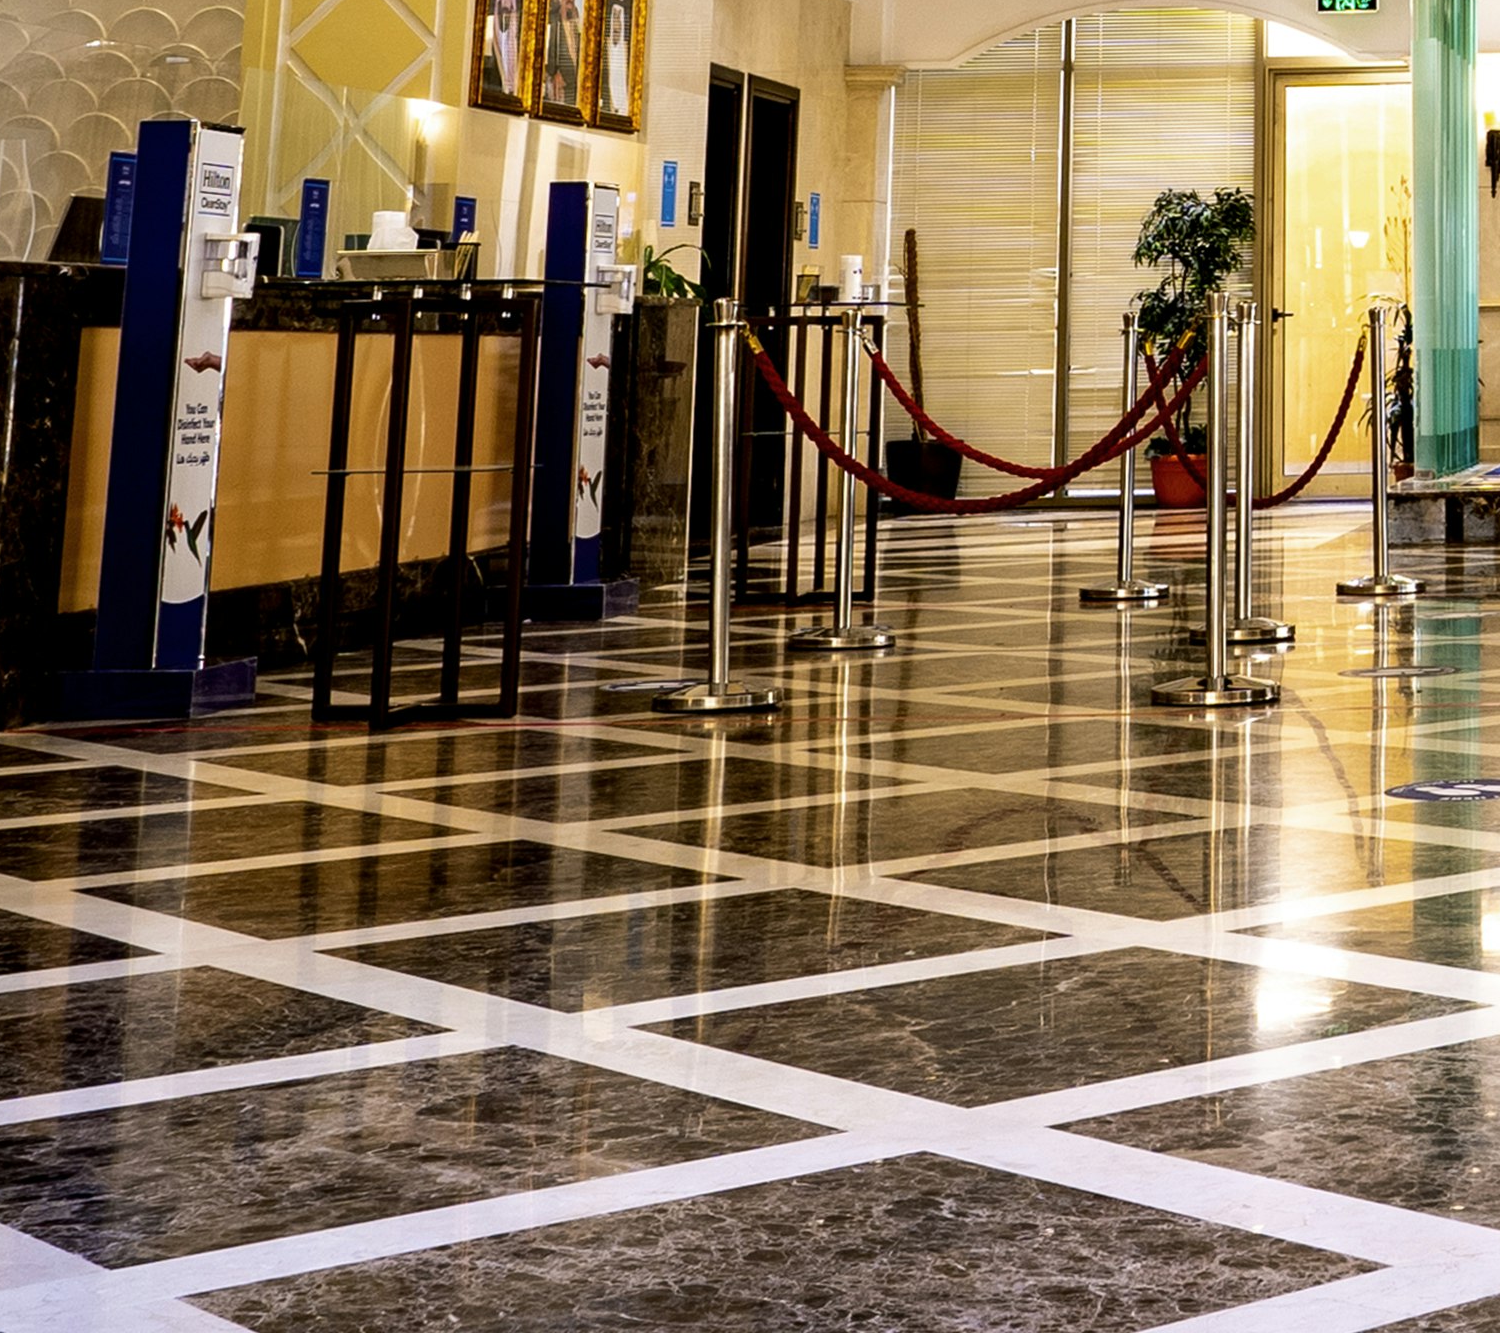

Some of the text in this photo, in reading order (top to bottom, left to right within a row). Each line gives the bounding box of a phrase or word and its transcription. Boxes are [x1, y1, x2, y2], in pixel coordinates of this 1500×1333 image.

[203, 170, 230, 190] Hilton
[595, 219, 612, 233] Hilton
[186, 403, 208, 414] You Can
[177, 418, 215, 430] Disinfect Your
[181, 433, 210, 445] Hand Here
